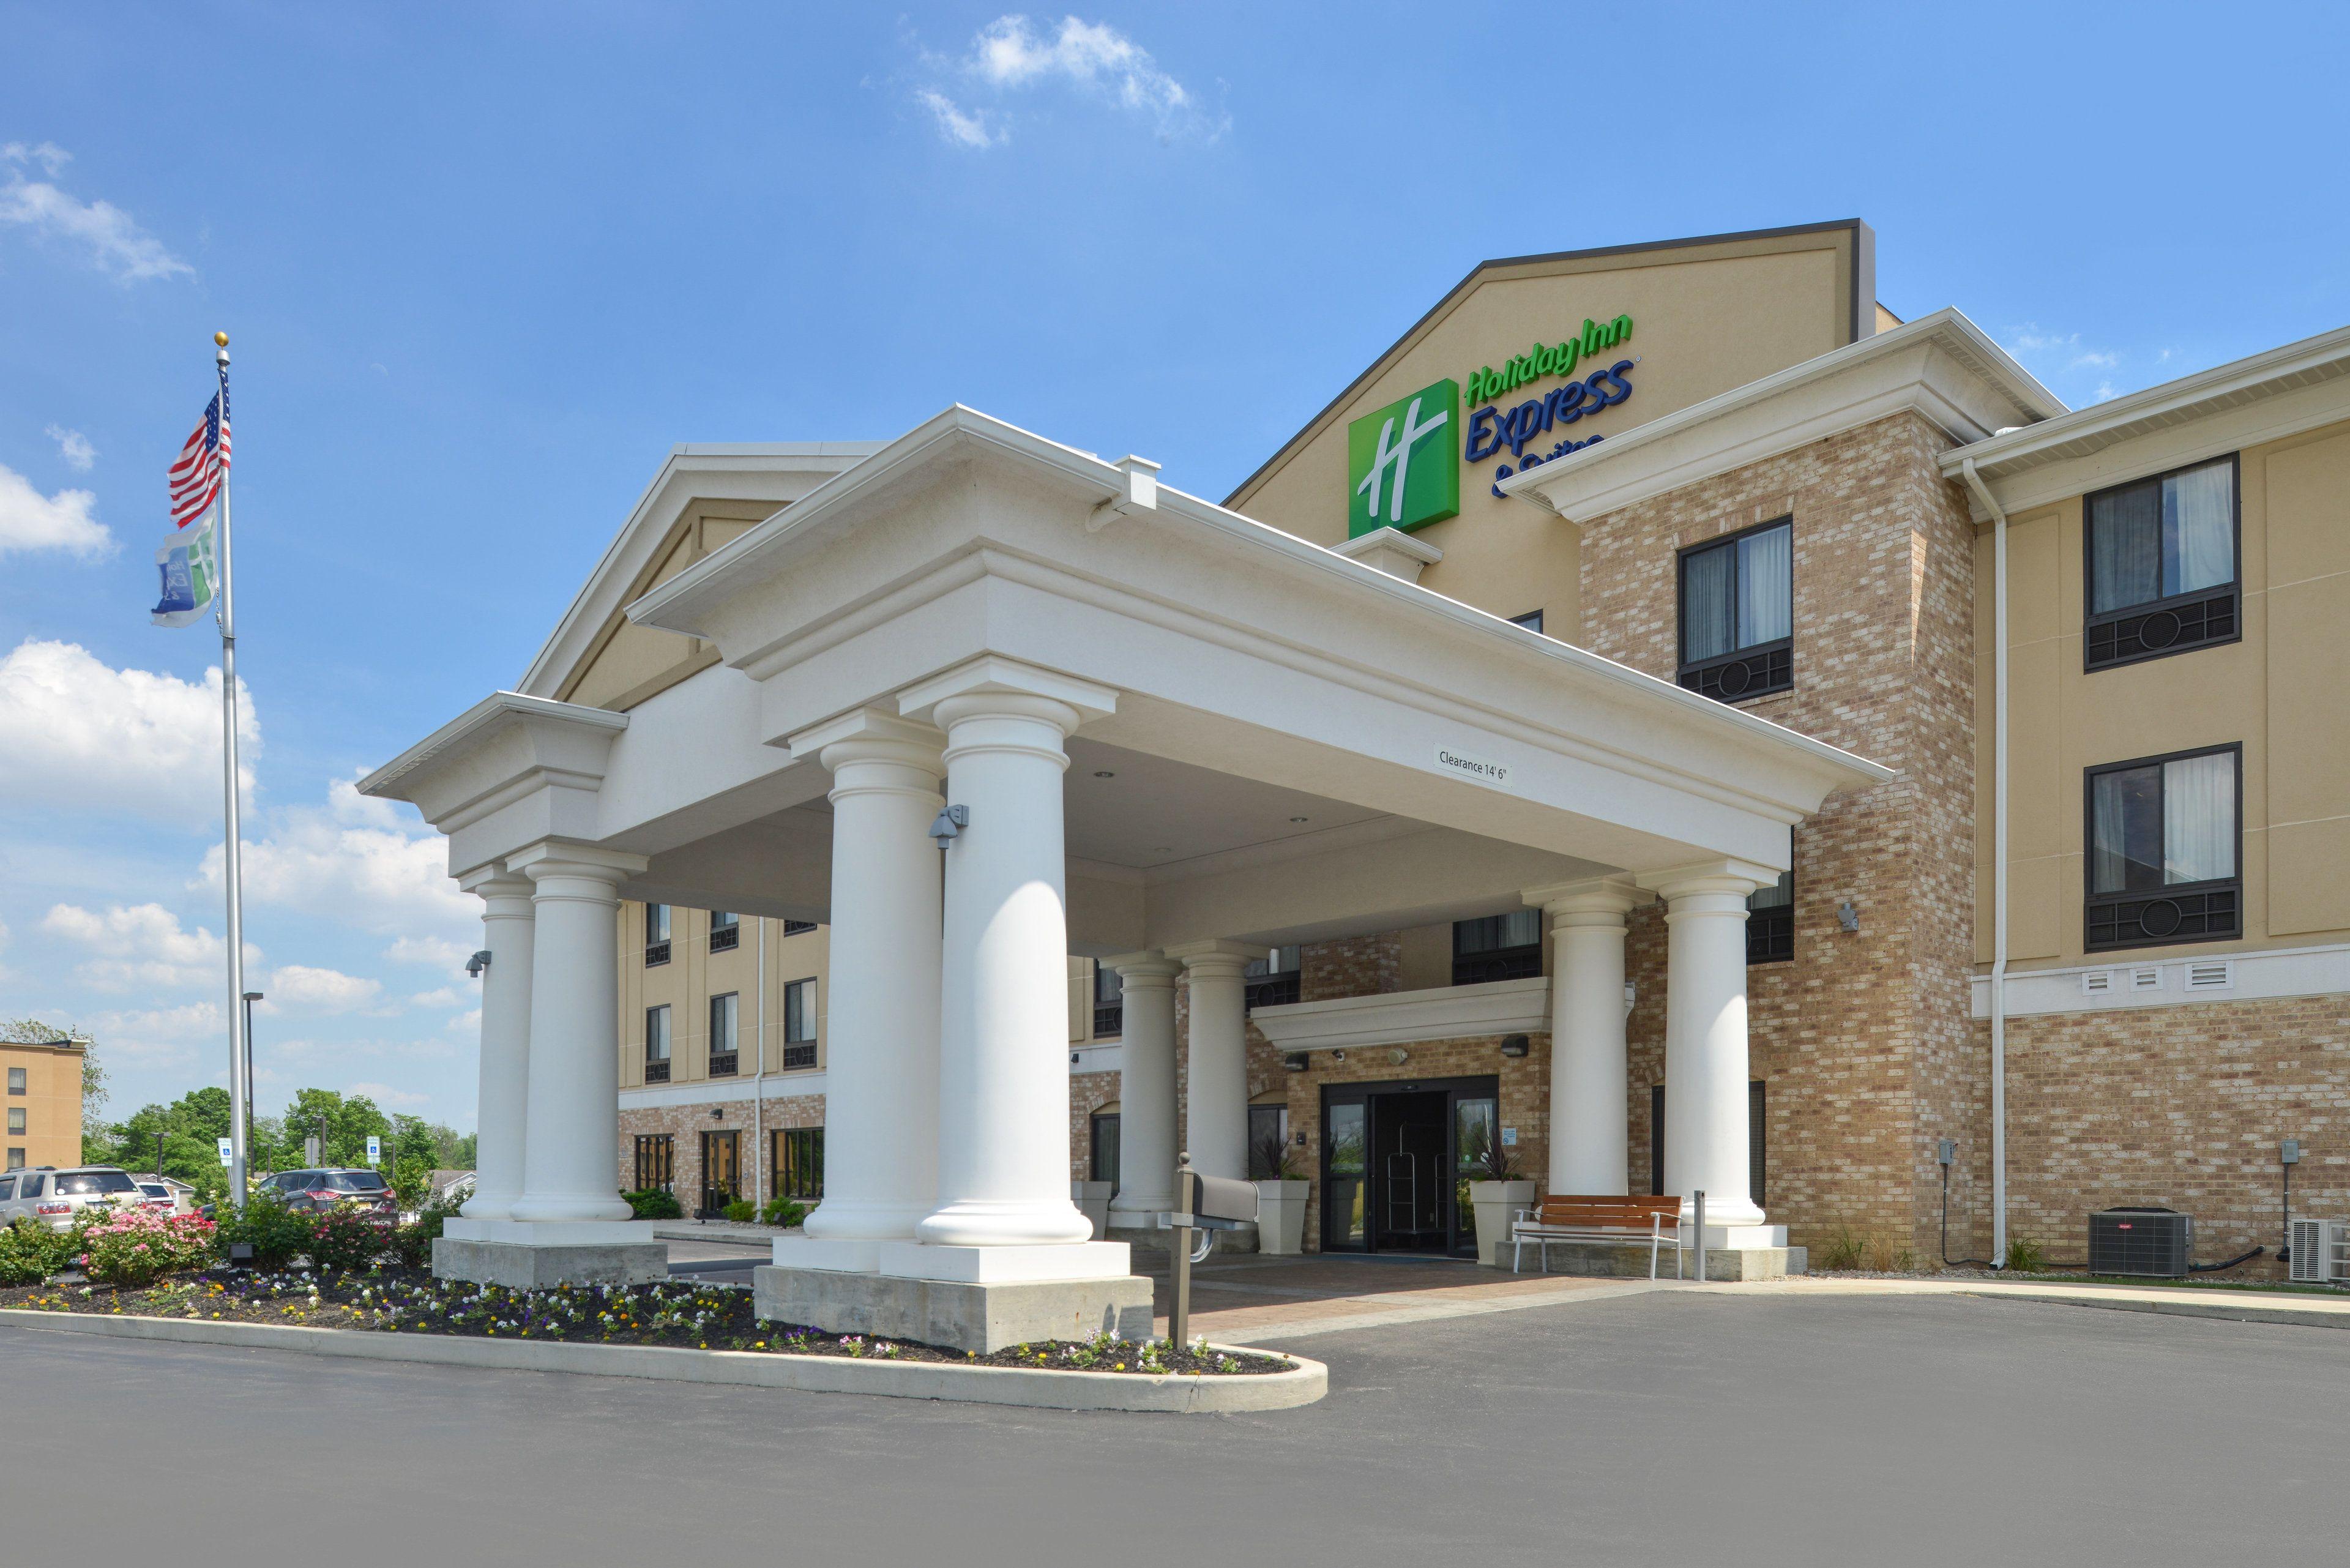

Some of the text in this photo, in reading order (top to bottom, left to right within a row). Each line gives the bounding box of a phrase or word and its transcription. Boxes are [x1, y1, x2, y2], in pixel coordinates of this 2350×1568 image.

[1464, 314, 1633, 409] Holiday Inn
[1465, 360, 1635, 463] Express
[1439, 751, 1483, 774] Clearance
[1485, 764, 1496, 777] 14'
